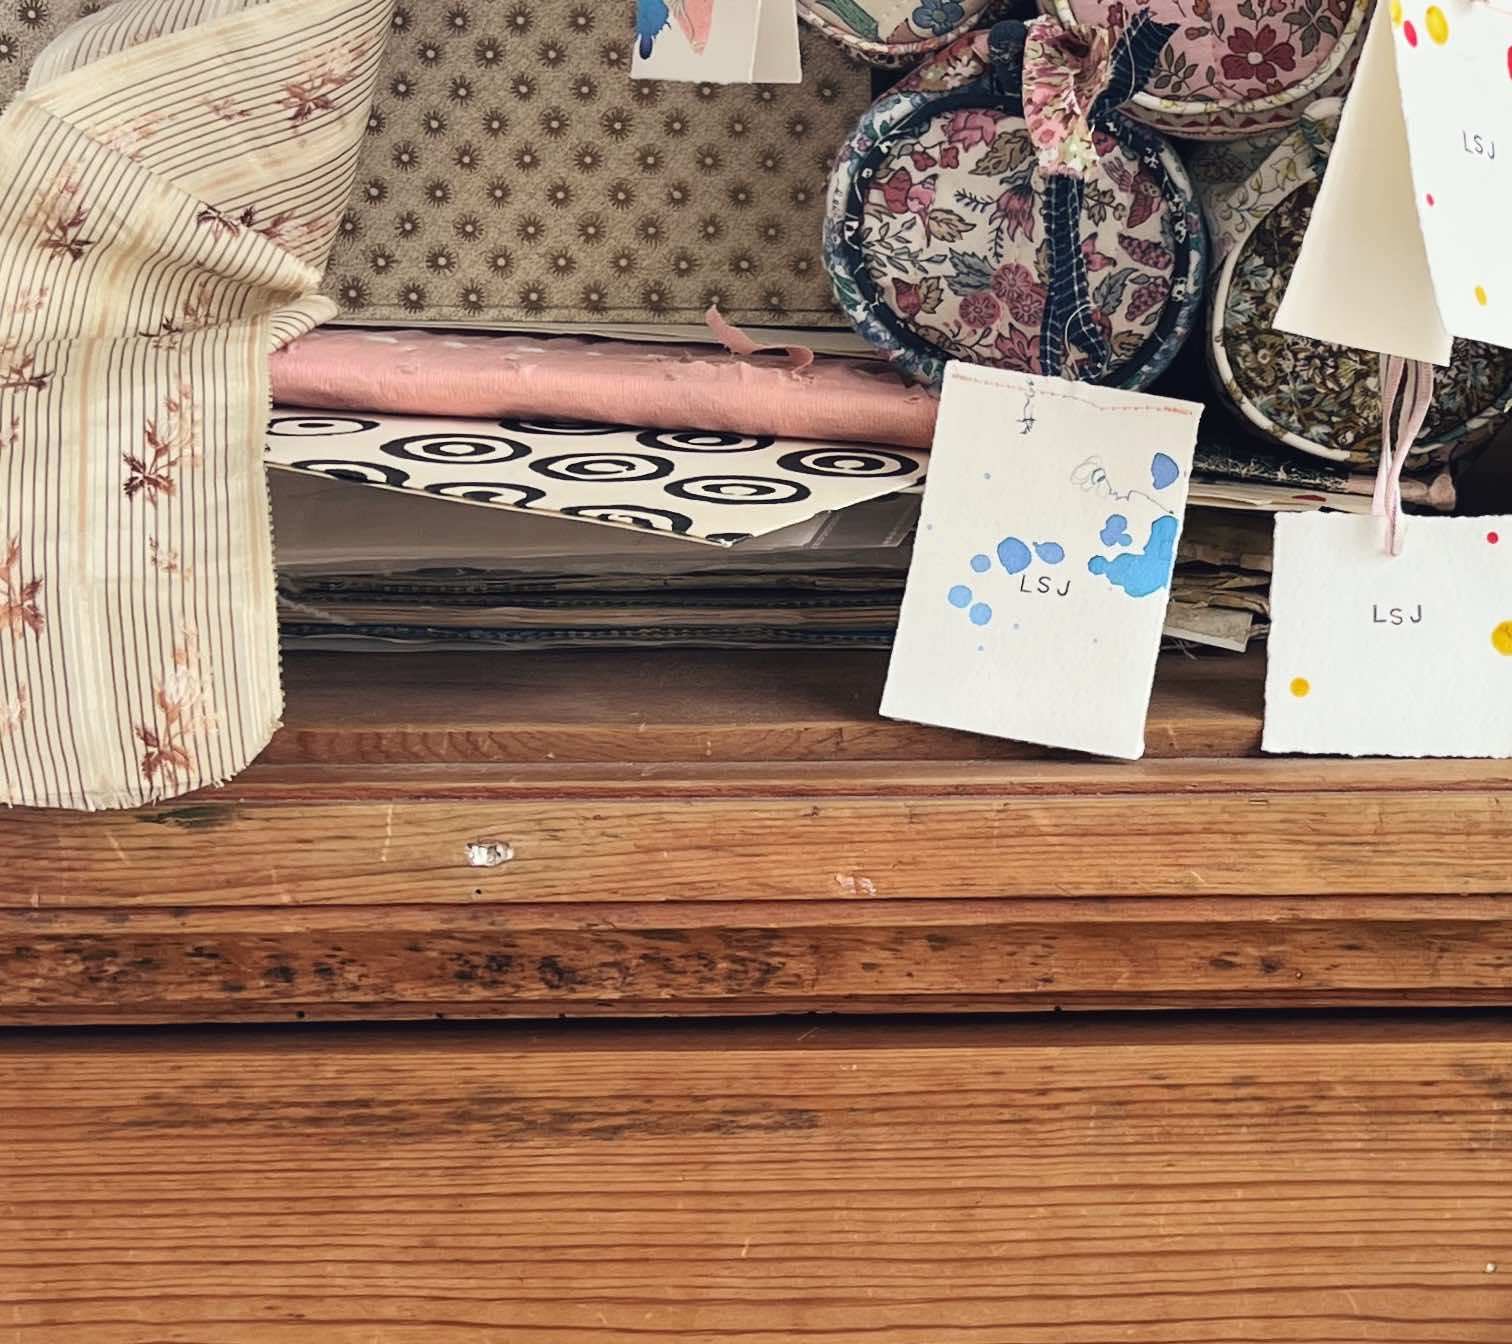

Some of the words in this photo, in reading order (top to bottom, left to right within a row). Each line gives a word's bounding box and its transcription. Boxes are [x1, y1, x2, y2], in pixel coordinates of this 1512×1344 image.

[1461, 130, 1495, 160] LSJ
[1019, 574, 1071, 597] LSJ
[1372, 604, 1423, 626] LSJ
